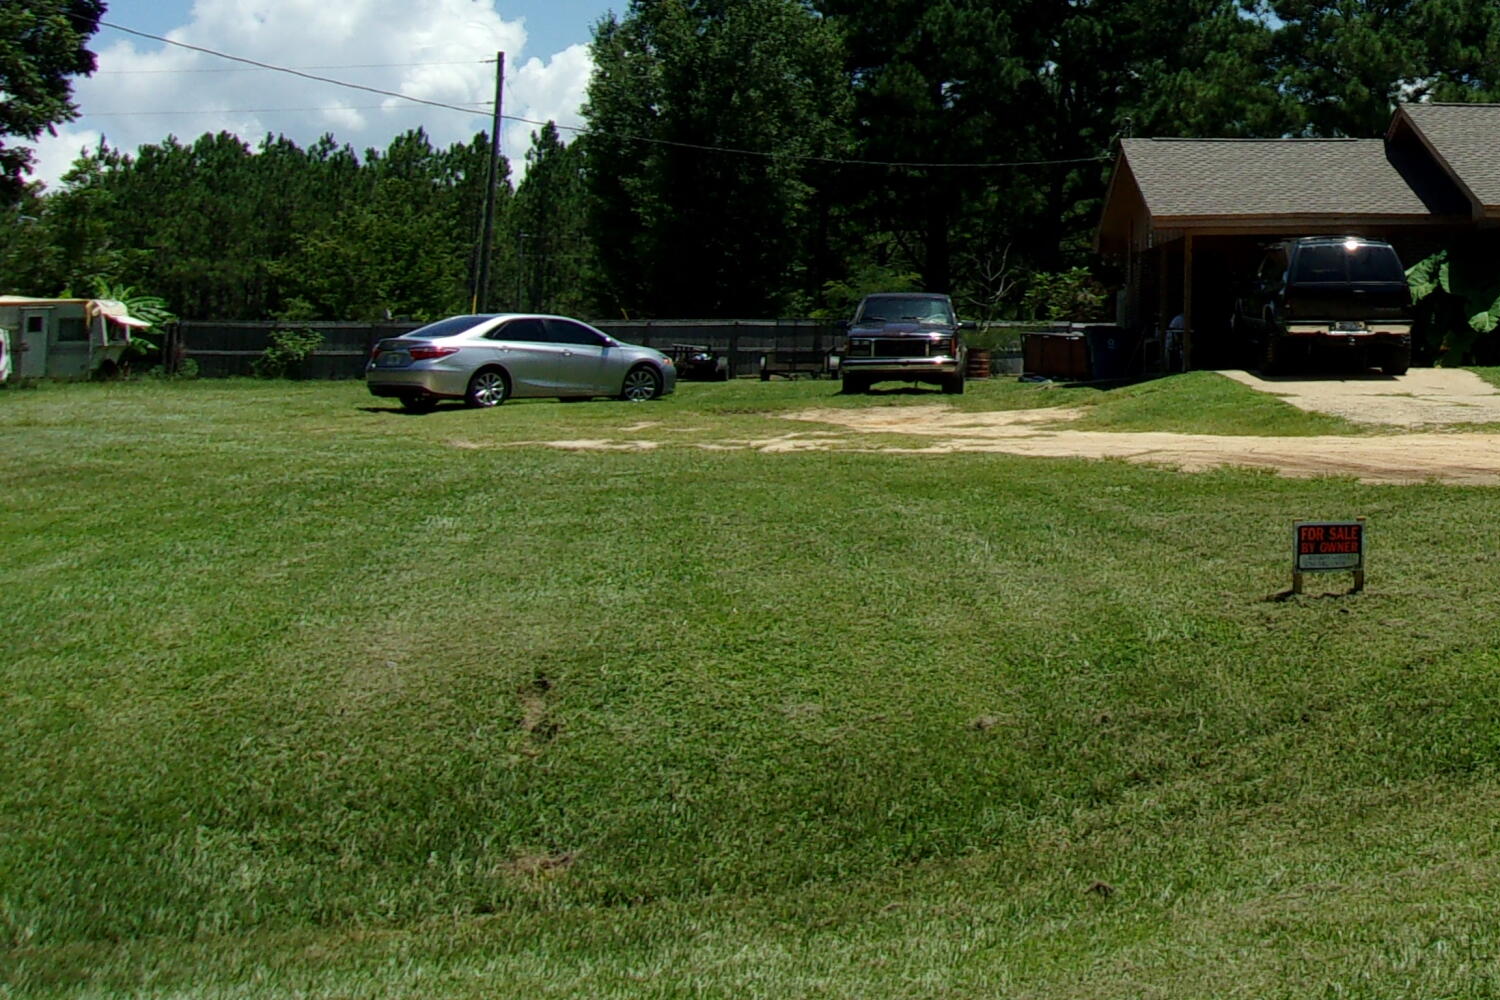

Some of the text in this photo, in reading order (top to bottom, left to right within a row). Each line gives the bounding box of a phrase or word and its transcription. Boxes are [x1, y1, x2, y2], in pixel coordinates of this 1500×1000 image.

[1301, 526, 1358, 540] FOR SALE
[1301, 542, 1358, 553] BY OWNER
